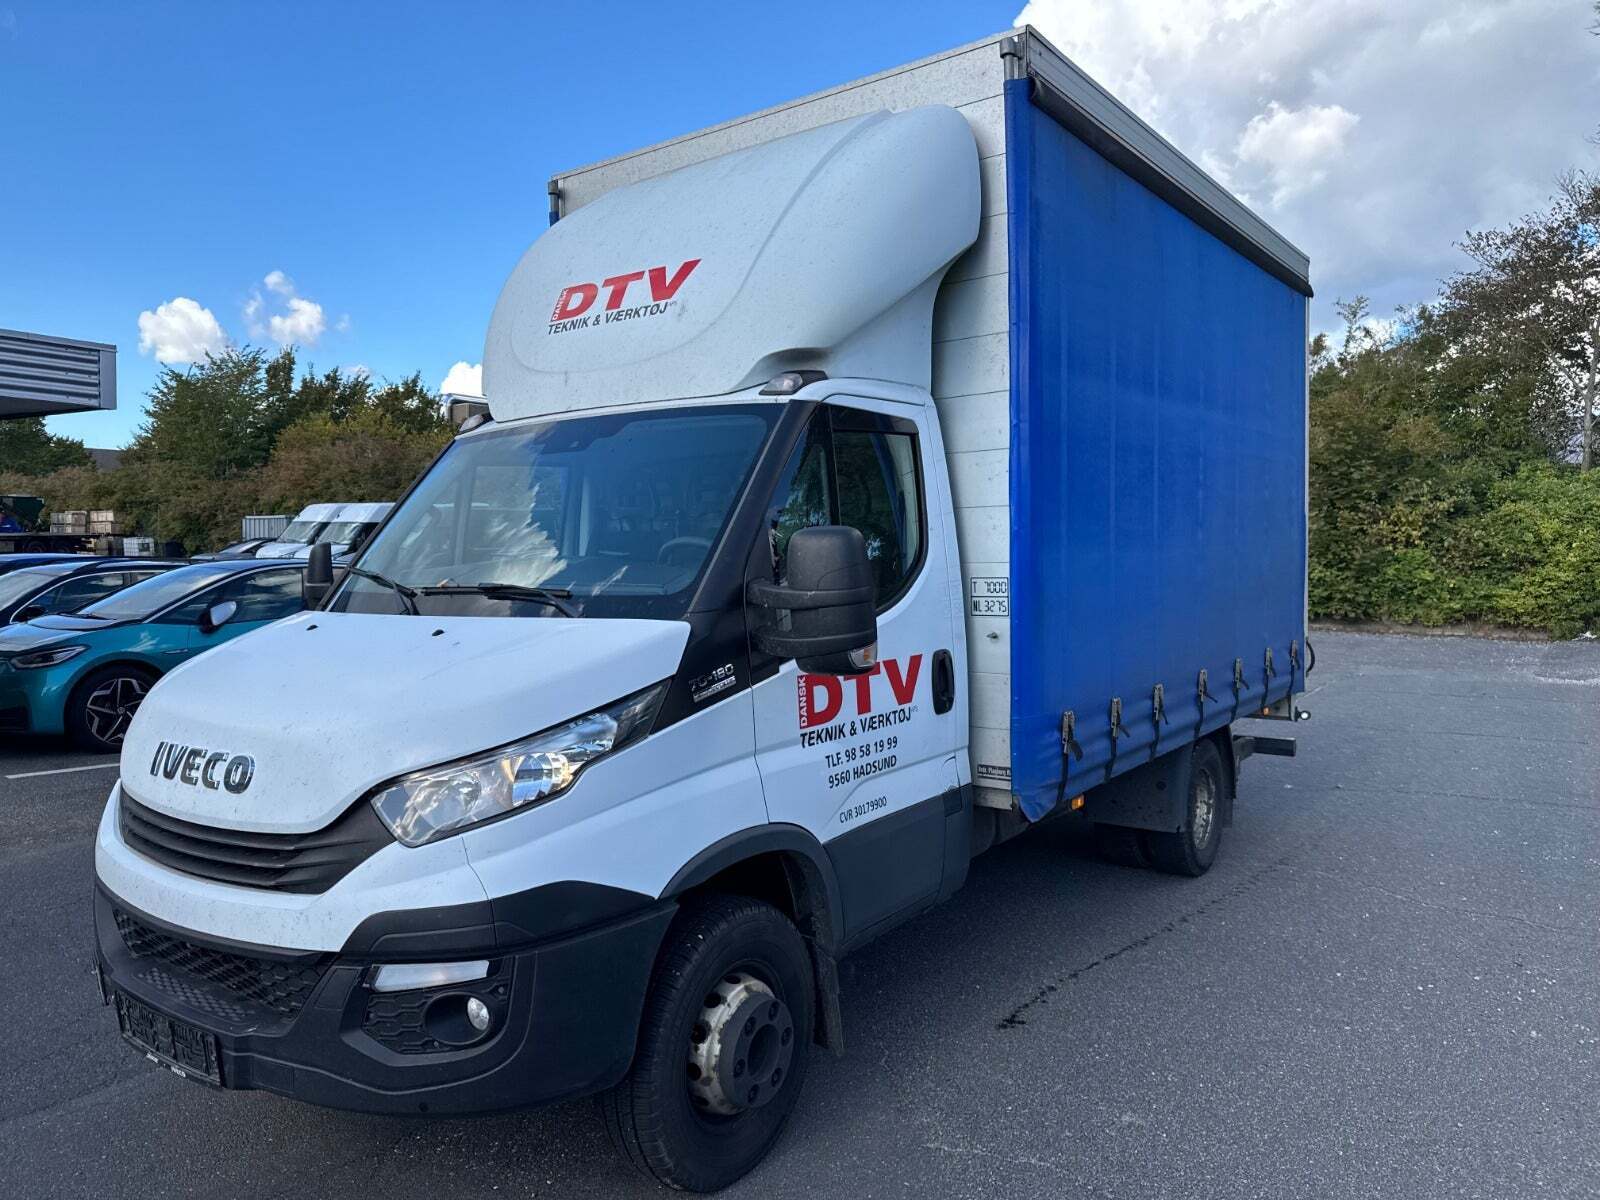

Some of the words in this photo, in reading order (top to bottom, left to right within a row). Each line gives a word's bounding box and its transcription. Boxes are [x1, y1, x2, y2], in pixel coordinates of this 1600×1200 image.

[551, 259, 702, 321] DTV
[548, 320, 589, 335] TEKNIK
[592, 314, 601, 326] &
[605, 302, 668, 324] VÆRKTØJ
[973, 581, 977, 593] T
[984, 600, 1007, 612] 3275
[799, 654, 923, 729] DTV
[800, 675, 808, 727] DANSK
[800, 723, 846, 748] TEKNIK
[849, 721, 857, 737] &
[860, 707, 911, 732] VÆRKTØJ
[150, 741, 255, 794] IVECO
[825, 753, 844, 768] TLF.
[845, 749, 857, 764] 98
[859, 744, 871, 758] 58
[874, 740, 885, 754] 19
[887, 736, 898, 748] 99
[828, 772, 851, 789] 9560
[853, 755, 897, 781] HADSUND
[839, 812, 854, 823] CVR
[854, 796, 888, 818] 30179900
